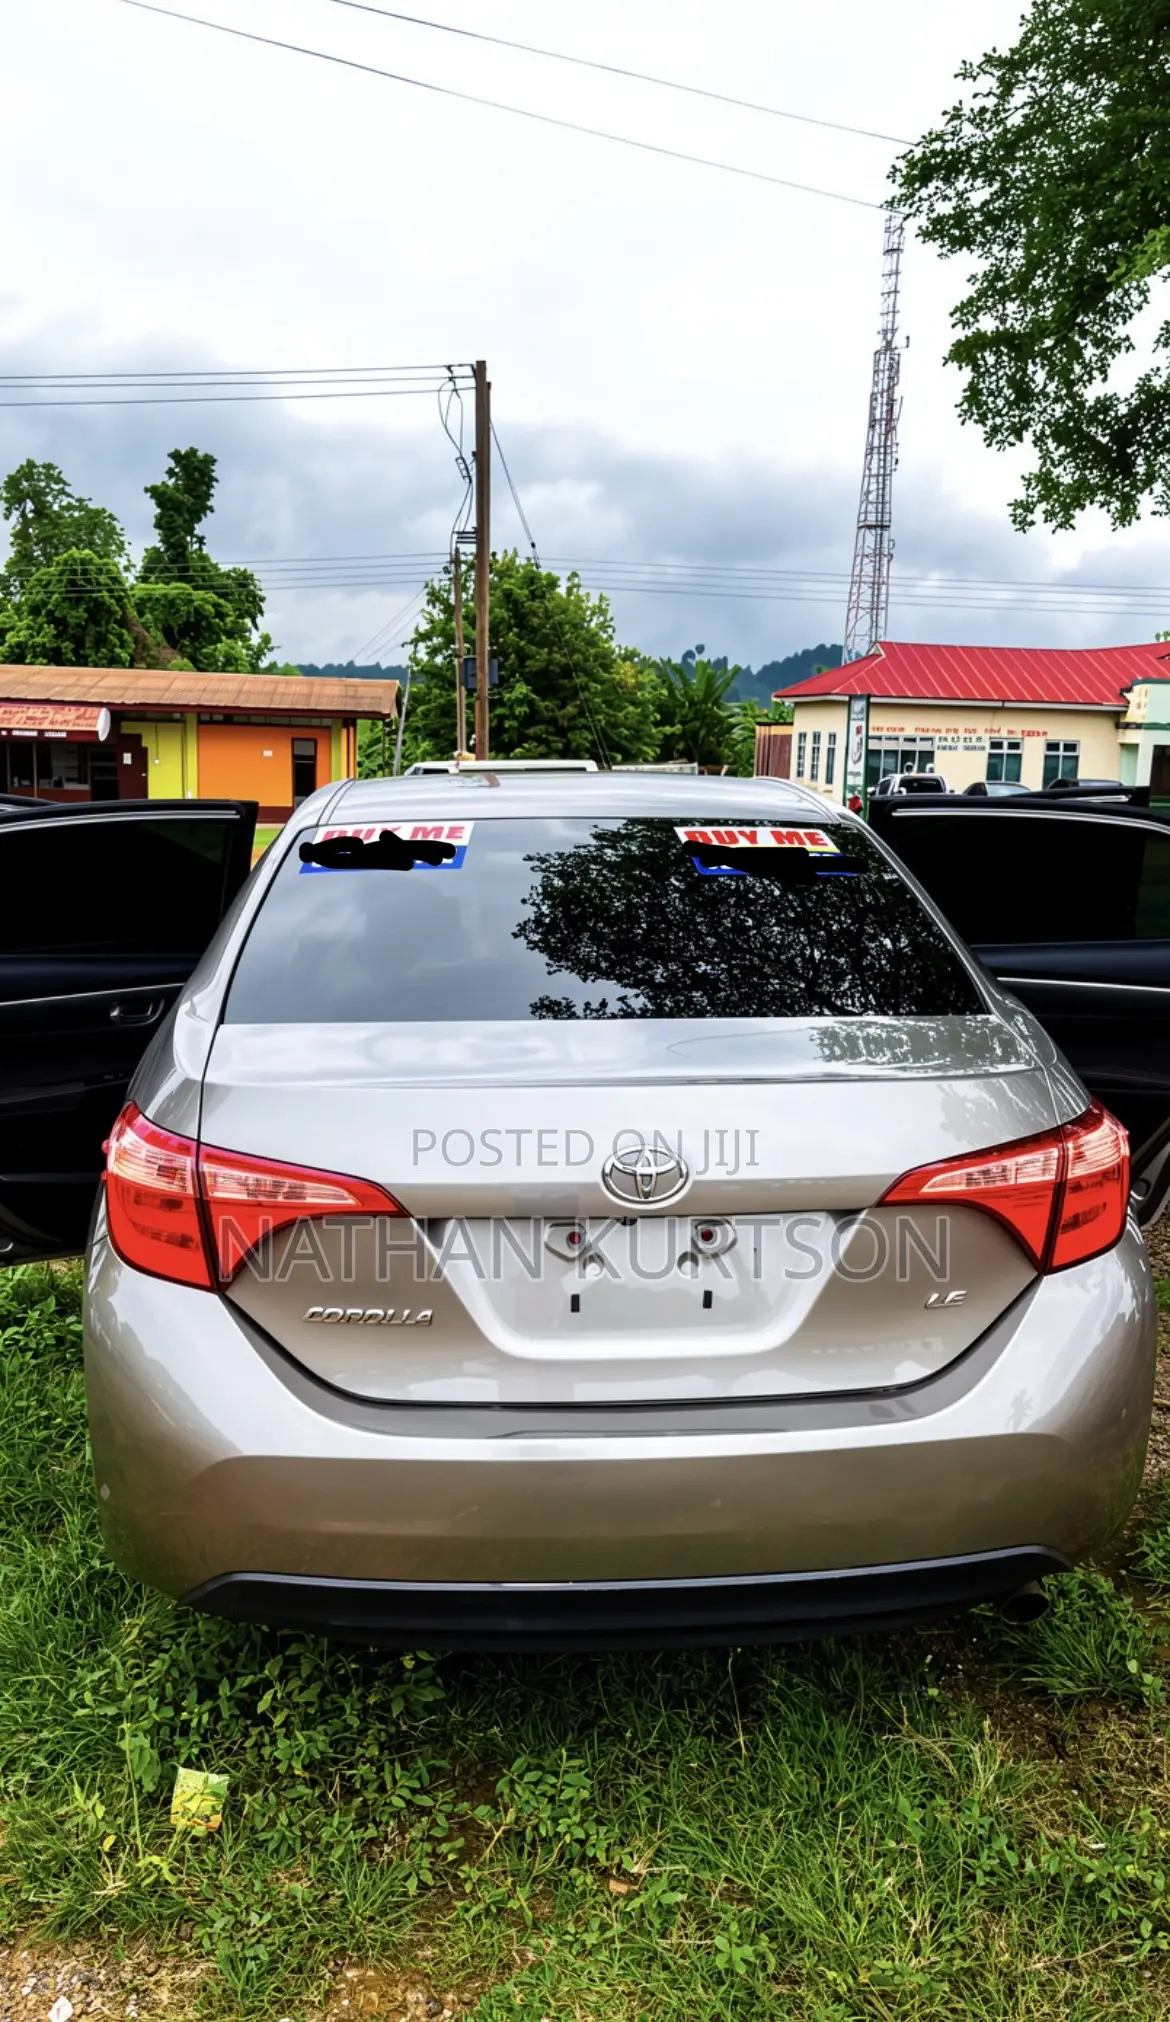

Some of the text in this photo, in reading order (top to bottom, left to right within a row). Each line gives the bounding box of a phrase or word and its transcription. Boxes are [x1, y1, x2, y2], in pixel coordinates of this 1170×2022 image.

[321, 826, 466, 843] BU ME
[684, 830, 829, 846] BUY ME
[924, 1290, 968, 1309] LE
[302, 1306, 433, 1326] COROLLA
